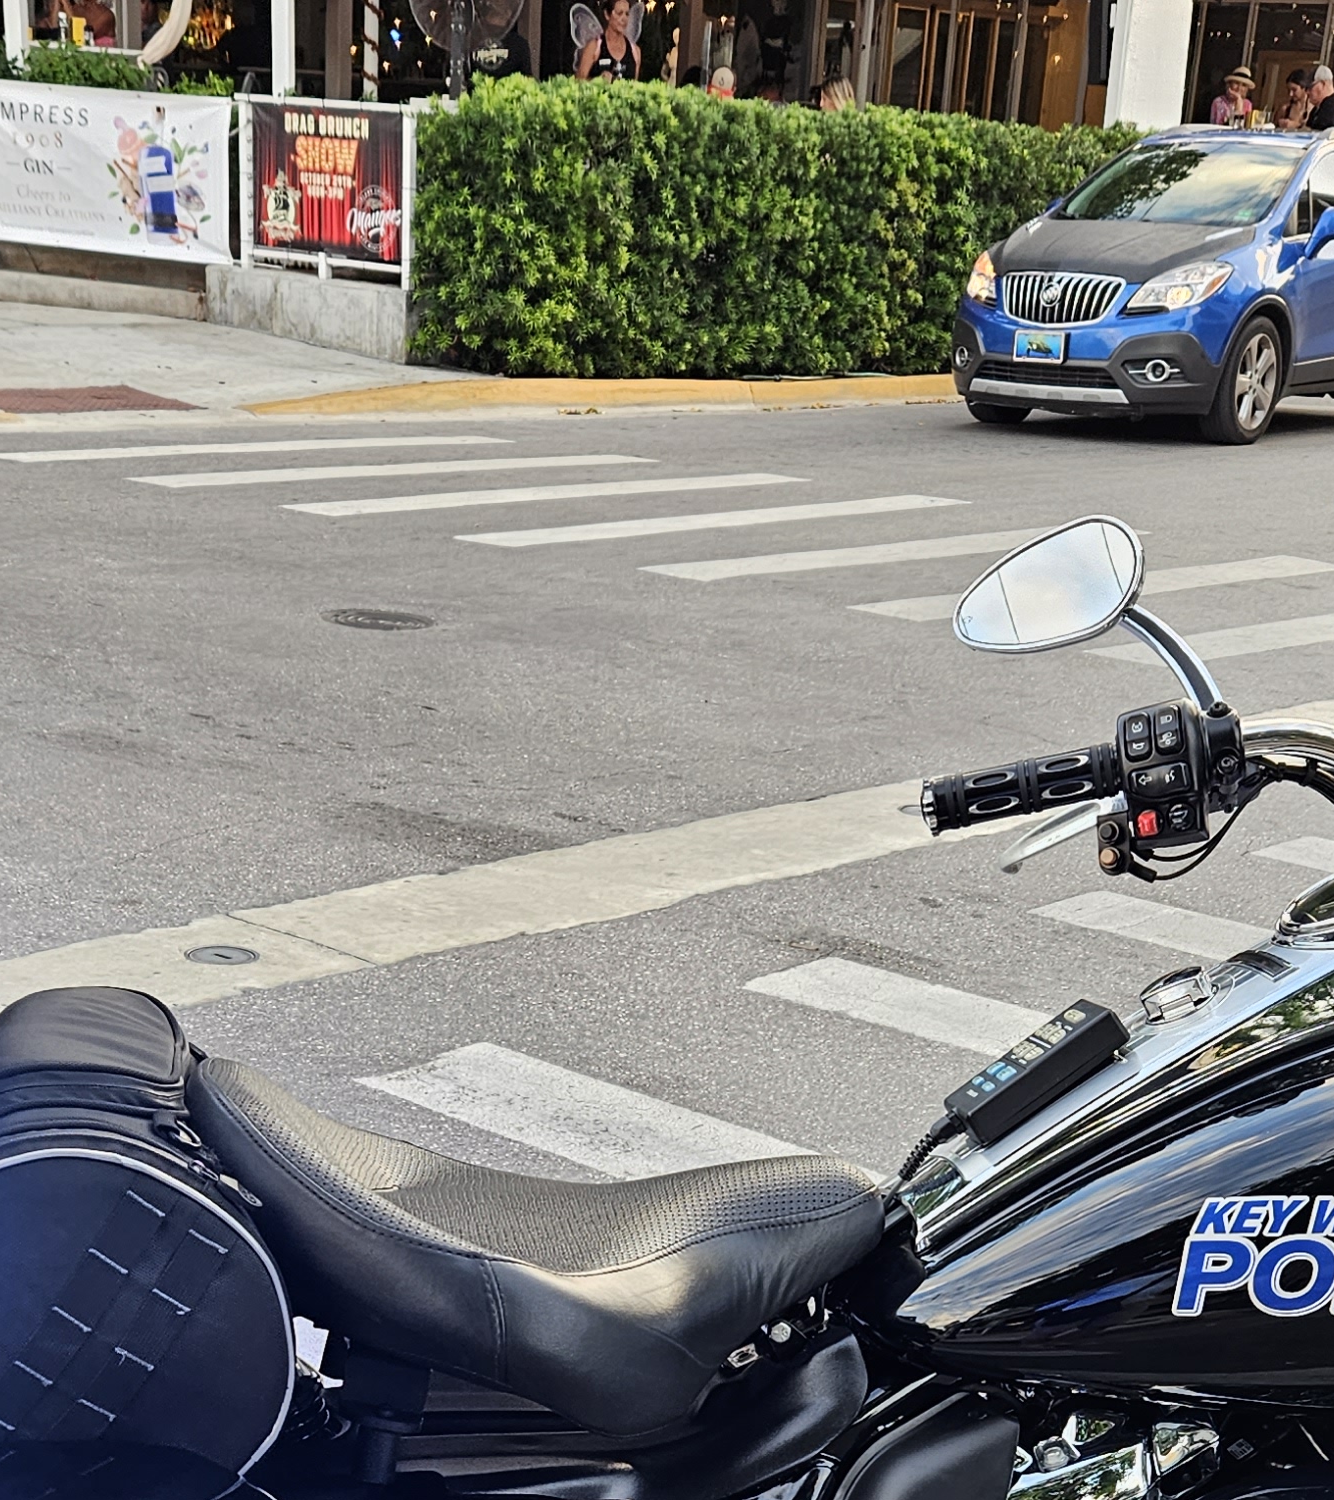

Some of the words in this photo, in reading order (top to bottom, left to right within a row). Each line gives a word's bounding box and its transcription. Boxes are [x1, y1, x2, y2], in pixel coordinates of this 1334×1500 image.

[11, 131, 64, 148] 1908
[284, 112, 315, 135] DRAG
[318, 114, 369, 140] BRUNCH
[23, 157, 54, 175] GIN
[295, 135, 359, 175] SHOW
[1190, 1195, 1309, 1238] KEY
